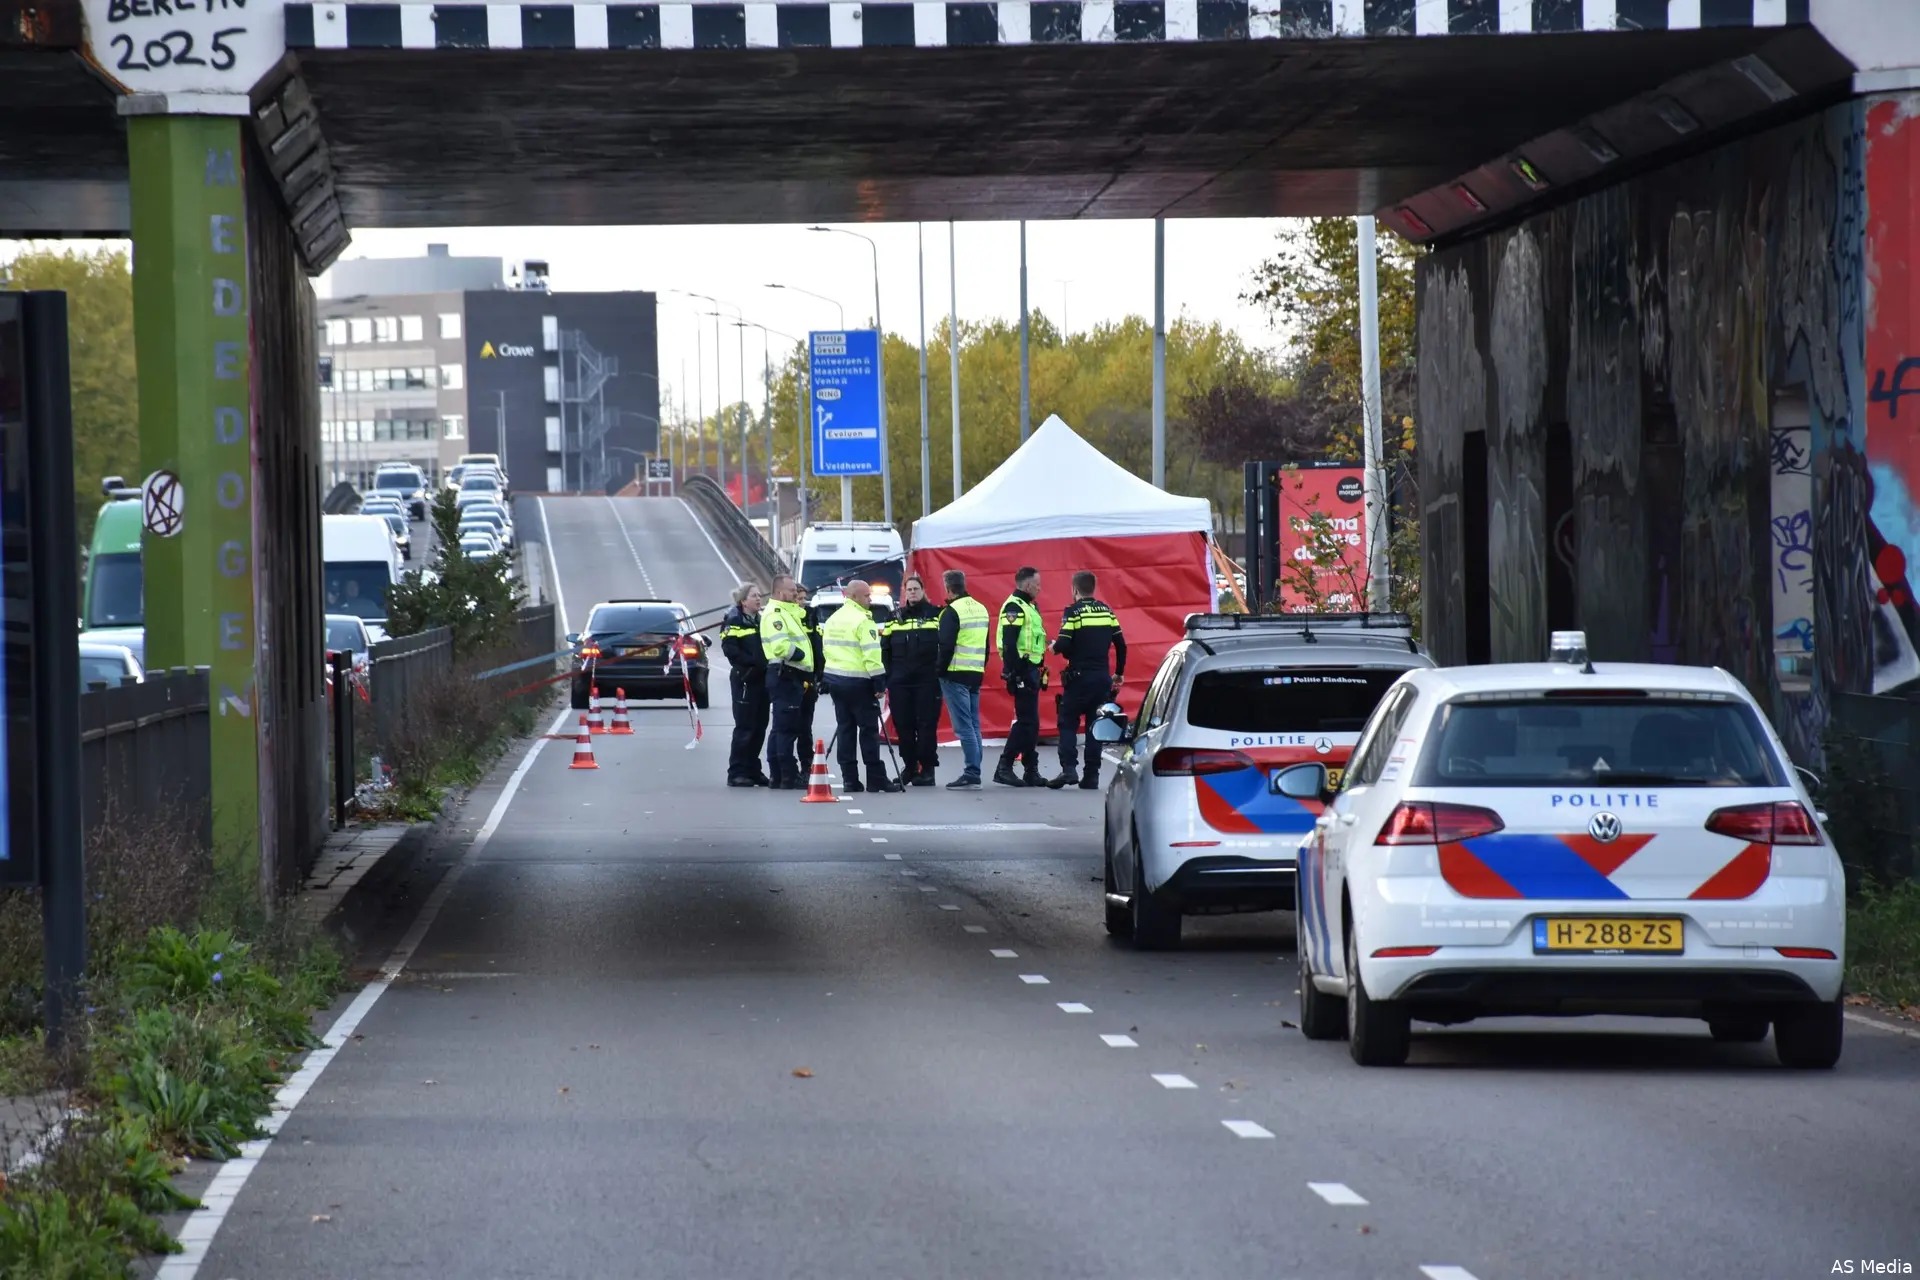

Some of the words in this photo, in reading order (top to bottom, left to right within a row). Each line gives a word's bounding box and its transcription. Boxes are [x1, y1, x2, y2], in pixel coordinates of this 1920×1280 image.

[108, 0, 247, 22] BER
[110, 28, 247, 71] 2025
[816, 335, 843, 344] Strijp
[499, 342, 535, 357] Crowe
[814, 358, 862, 366] Antwerpen
[814, 367, 863, 375] Maastricht
[814, 377, 840, 385] Venlo
[204, 148, 251, 717] MEDEDOGEN
[825, 462, 872, 470] Veldhoven
[1322, 676, 1368, 684] Eindhoven
[1231, 735, 1306, 747] POLITIE
[1552, 794, 1659, 807] POLITIE
[1557, 923, 1672, 945] H-288-ZS
